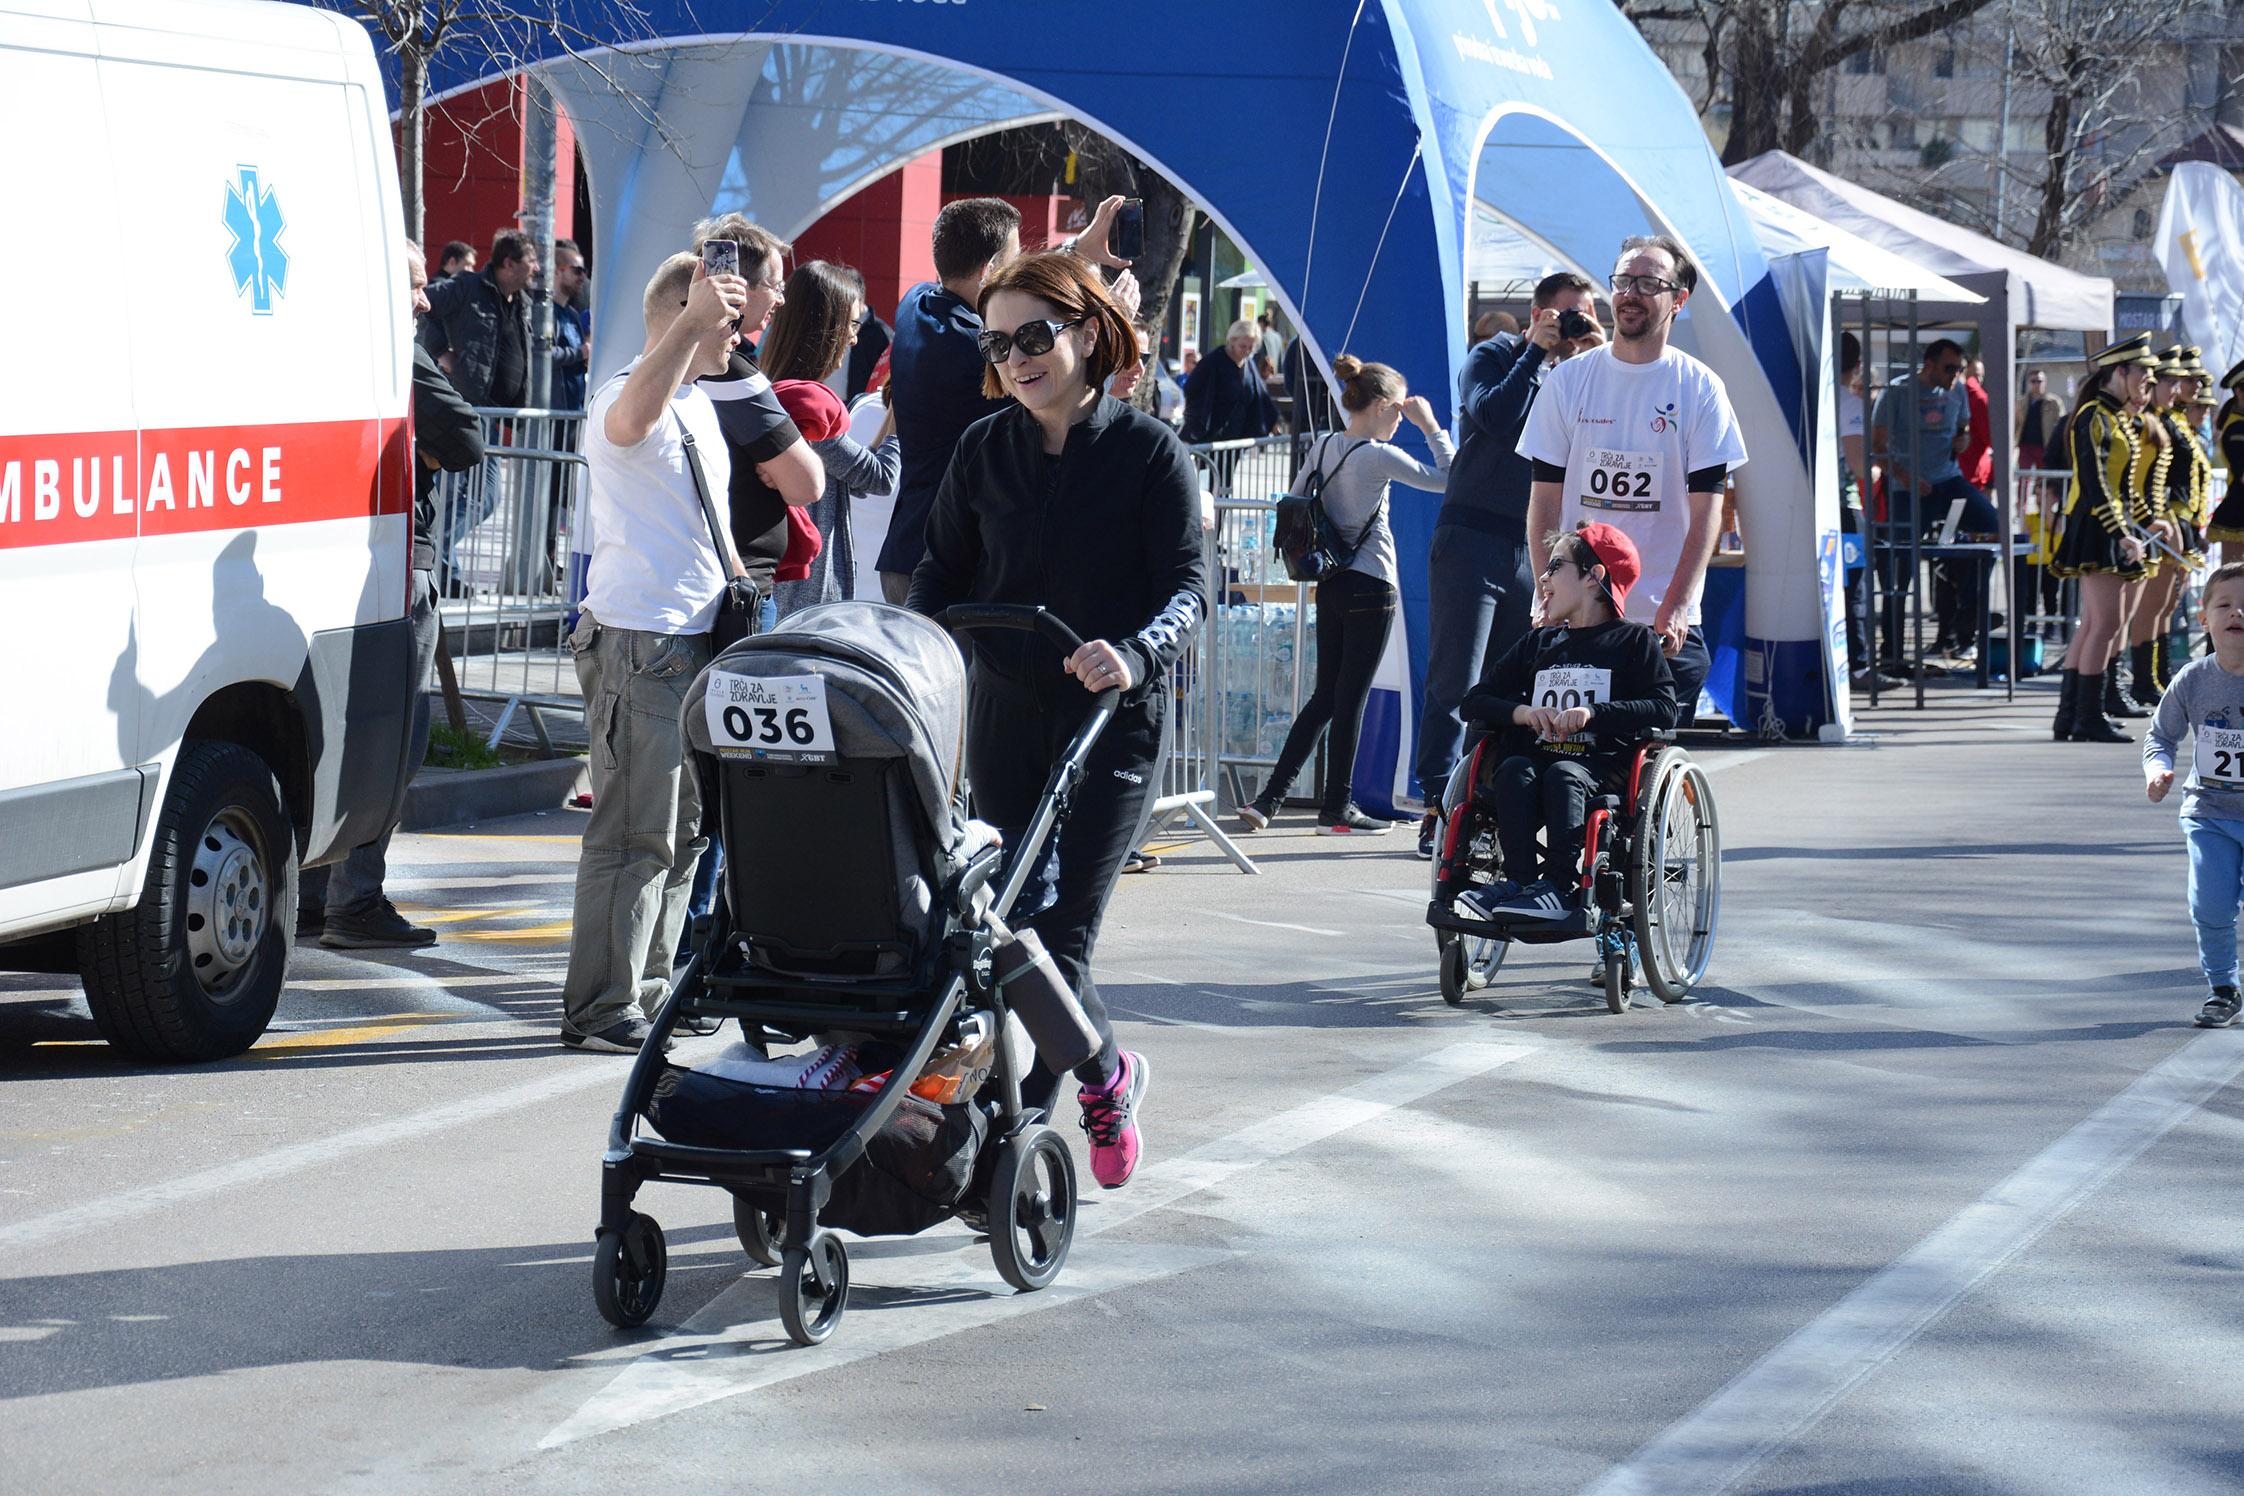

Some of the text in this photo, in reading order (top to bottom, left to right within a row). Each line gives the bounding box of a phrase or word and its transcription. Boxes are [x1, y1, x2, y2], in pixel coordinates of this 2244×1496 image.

[1590, 468, 1652, 497] 062
[729, 677, 748, 693] TRČI
[750, 682, 764, 693] ZA
[730, 690, 778, 704] ZDRAVLJE
[722, 705, 815, 745] 036
[1113, 770, 1142, 784] adidas
